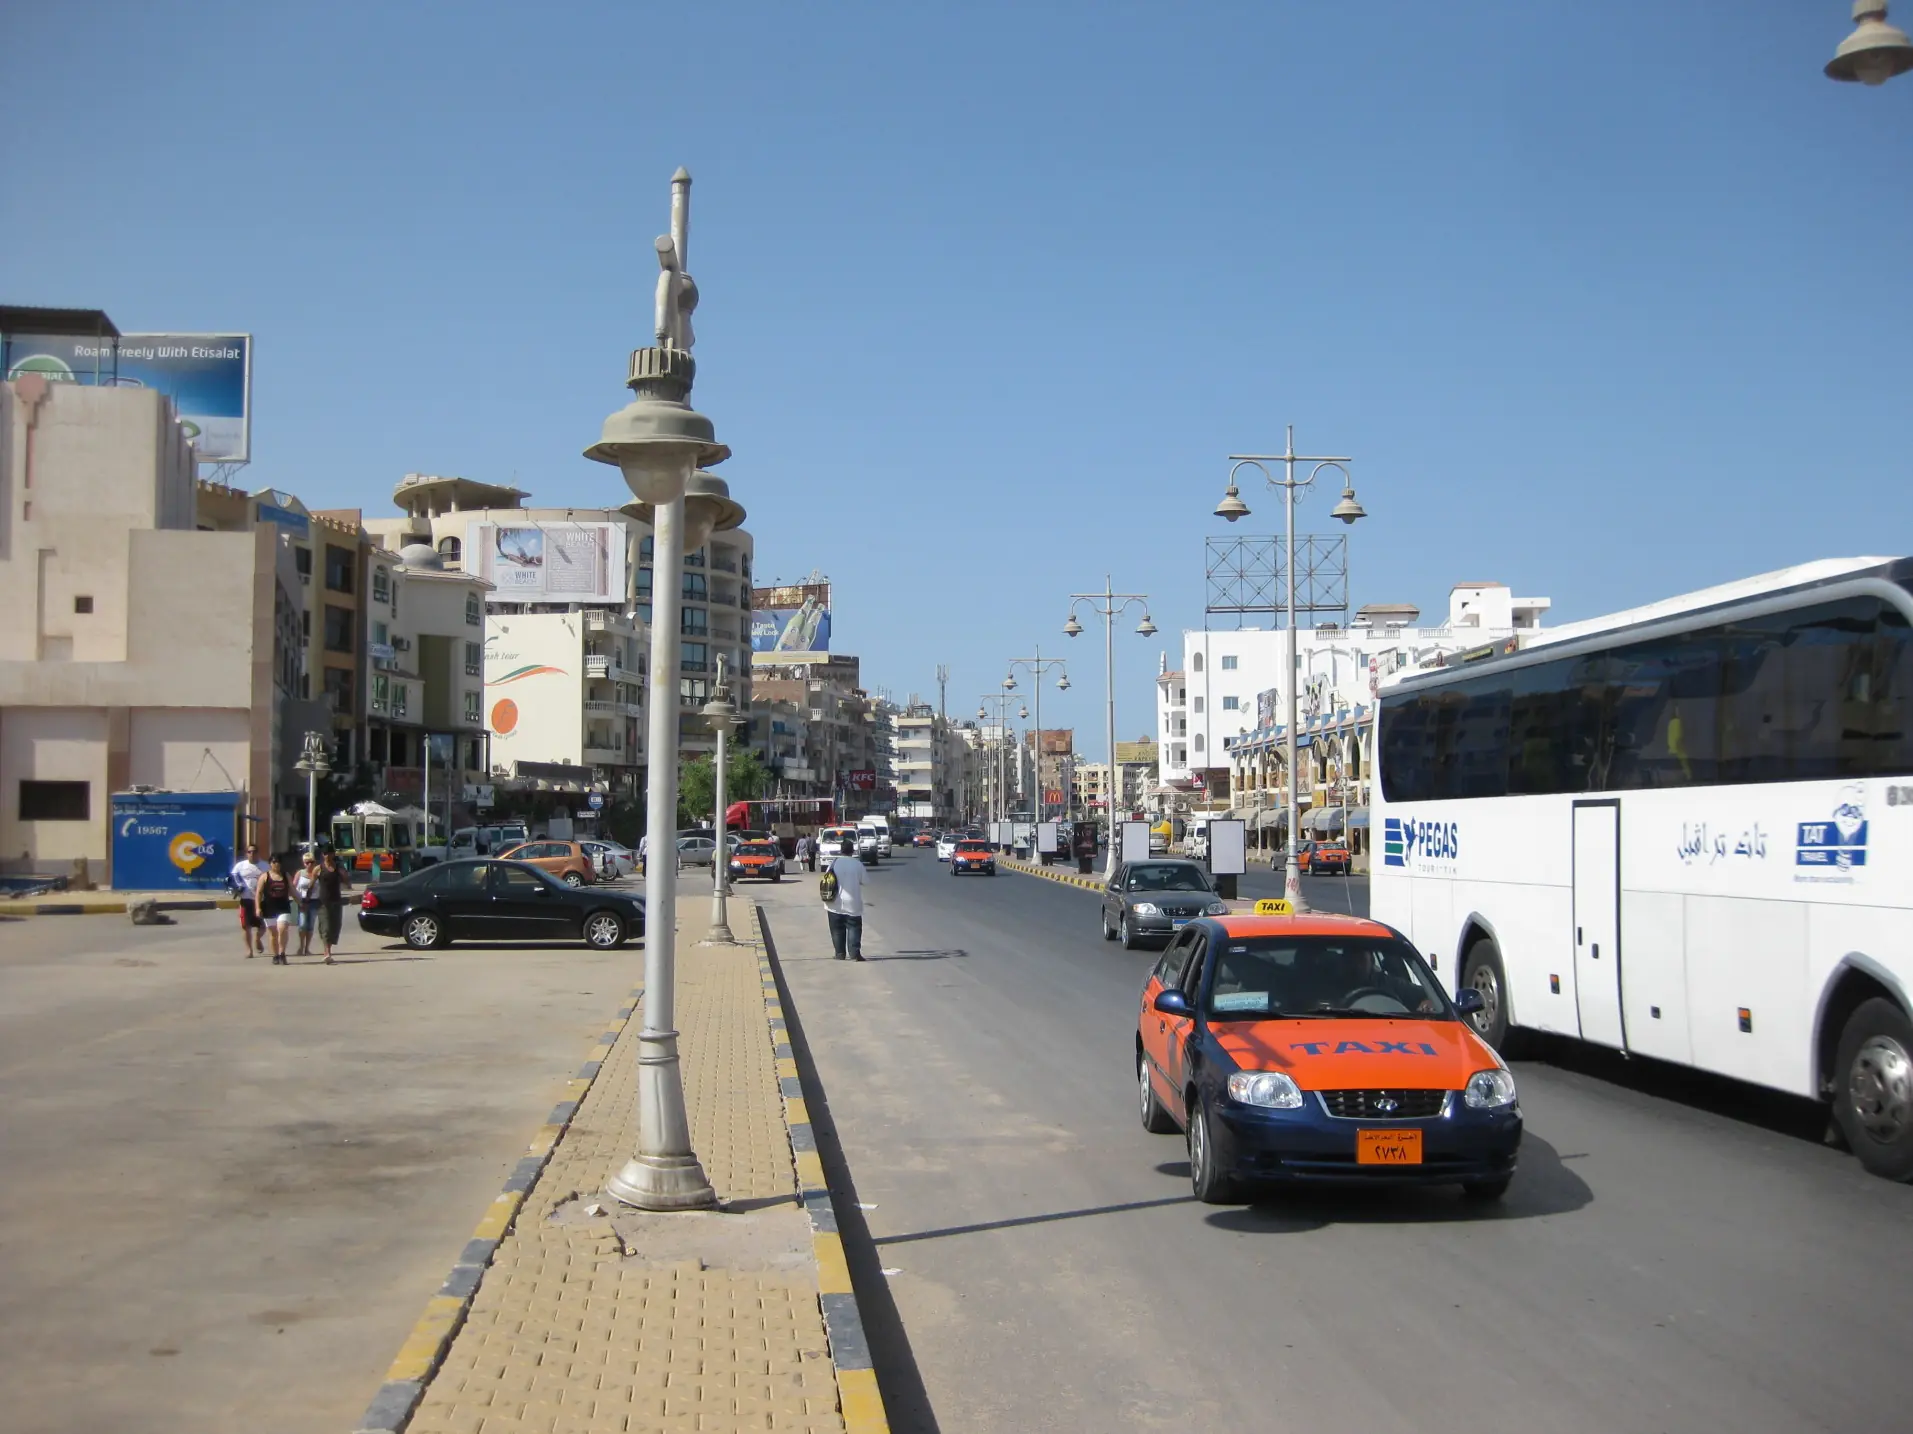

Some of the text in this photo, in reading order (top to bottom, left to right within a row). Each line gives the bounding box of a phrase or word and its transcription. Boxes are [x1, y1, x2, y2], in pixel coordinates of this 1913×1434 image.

[74, 345, 110, 357] Roam
[158, 346, 188, 358] With
[192, 346, 241, 359] Etisalat
[566, 532, 595, 541] WHITE
[852, 773, 875, 781] KFC
[137, 826, 168, 836] 19567
[1802, 825, 1828, 844] TAT
[1418, 821, 1458, 860] PEGAS
[1261, 902, 1286, 911] TAXI
[1289, 1041, 1438, 1056] TAXI
